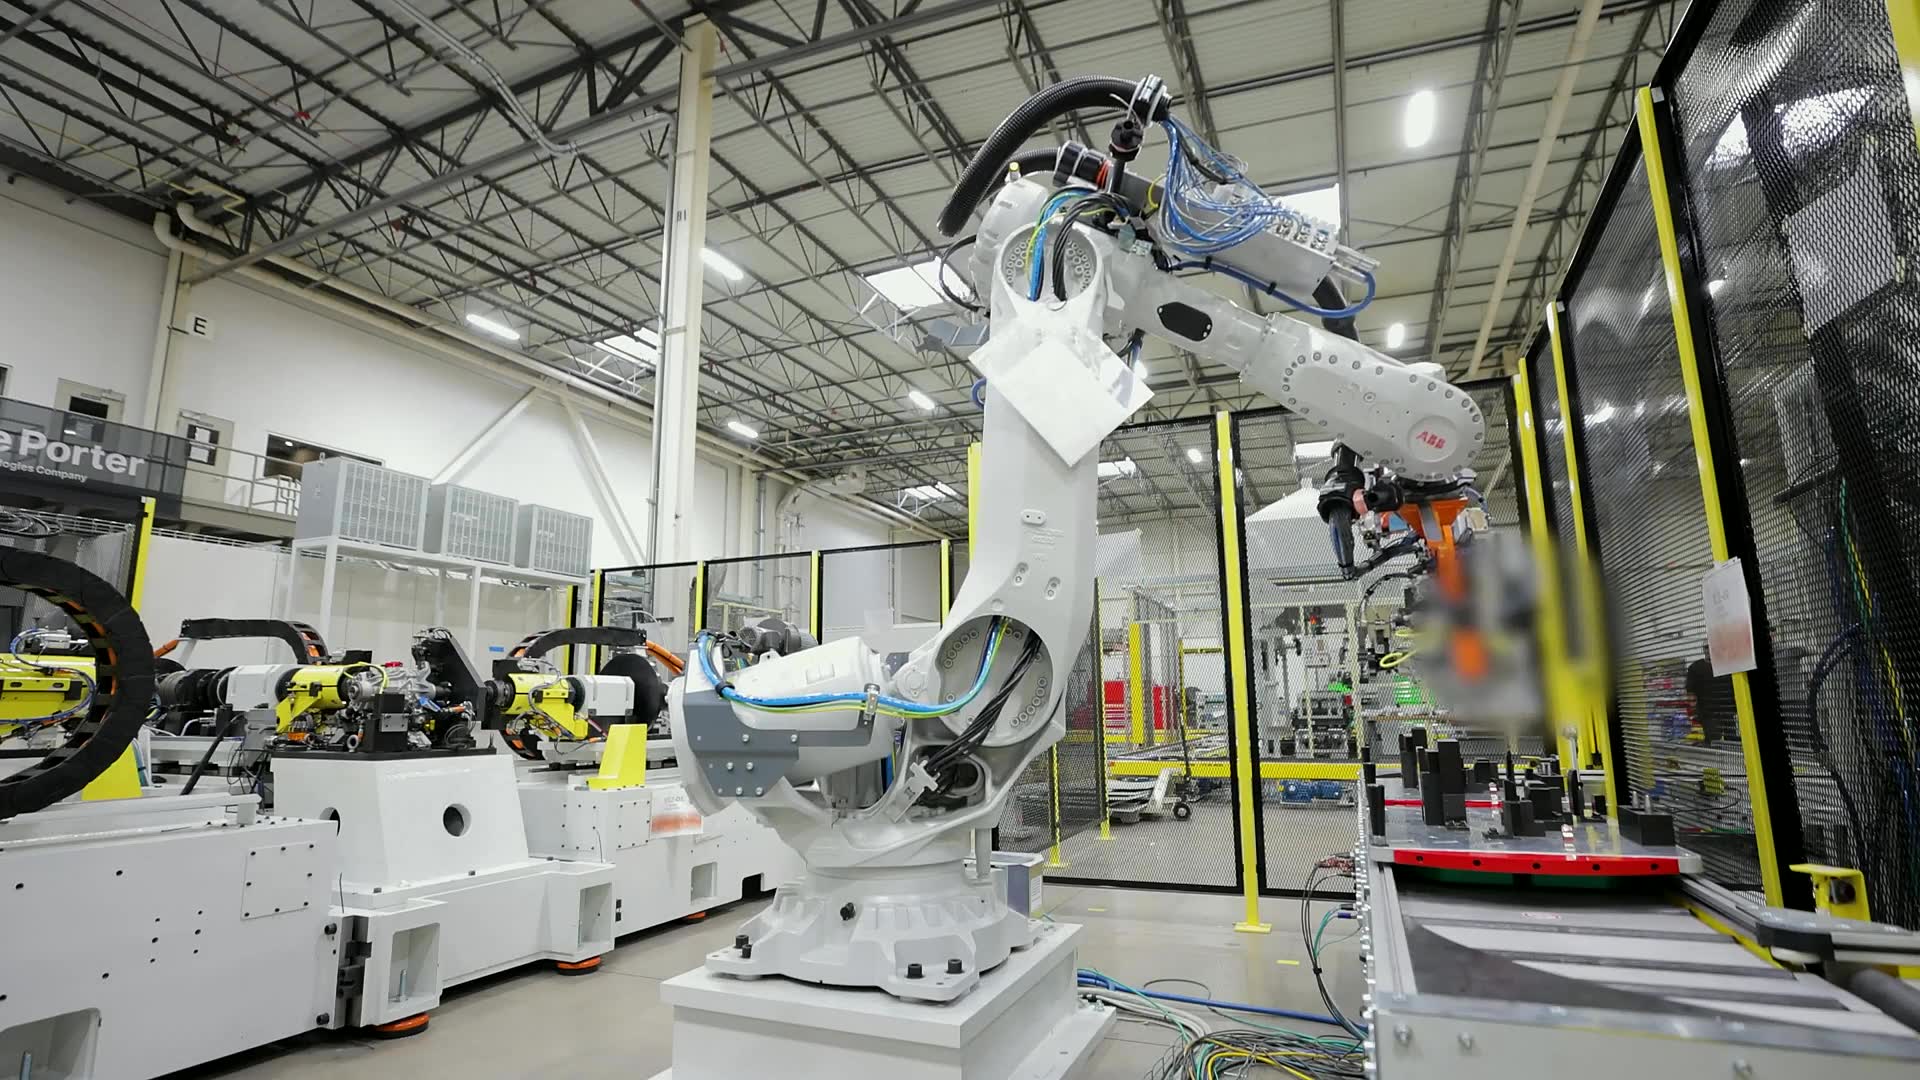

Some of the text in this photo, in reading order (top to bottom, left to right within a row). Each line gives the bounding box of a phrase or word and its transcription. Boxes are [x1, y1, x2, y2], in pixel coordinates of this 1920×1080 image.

[193, 316, 208, 336] E
[1415, 431, 1446, 449] ABB
[18, 427, 146, 477] Porter
[35, 464, 88, 483] Company
